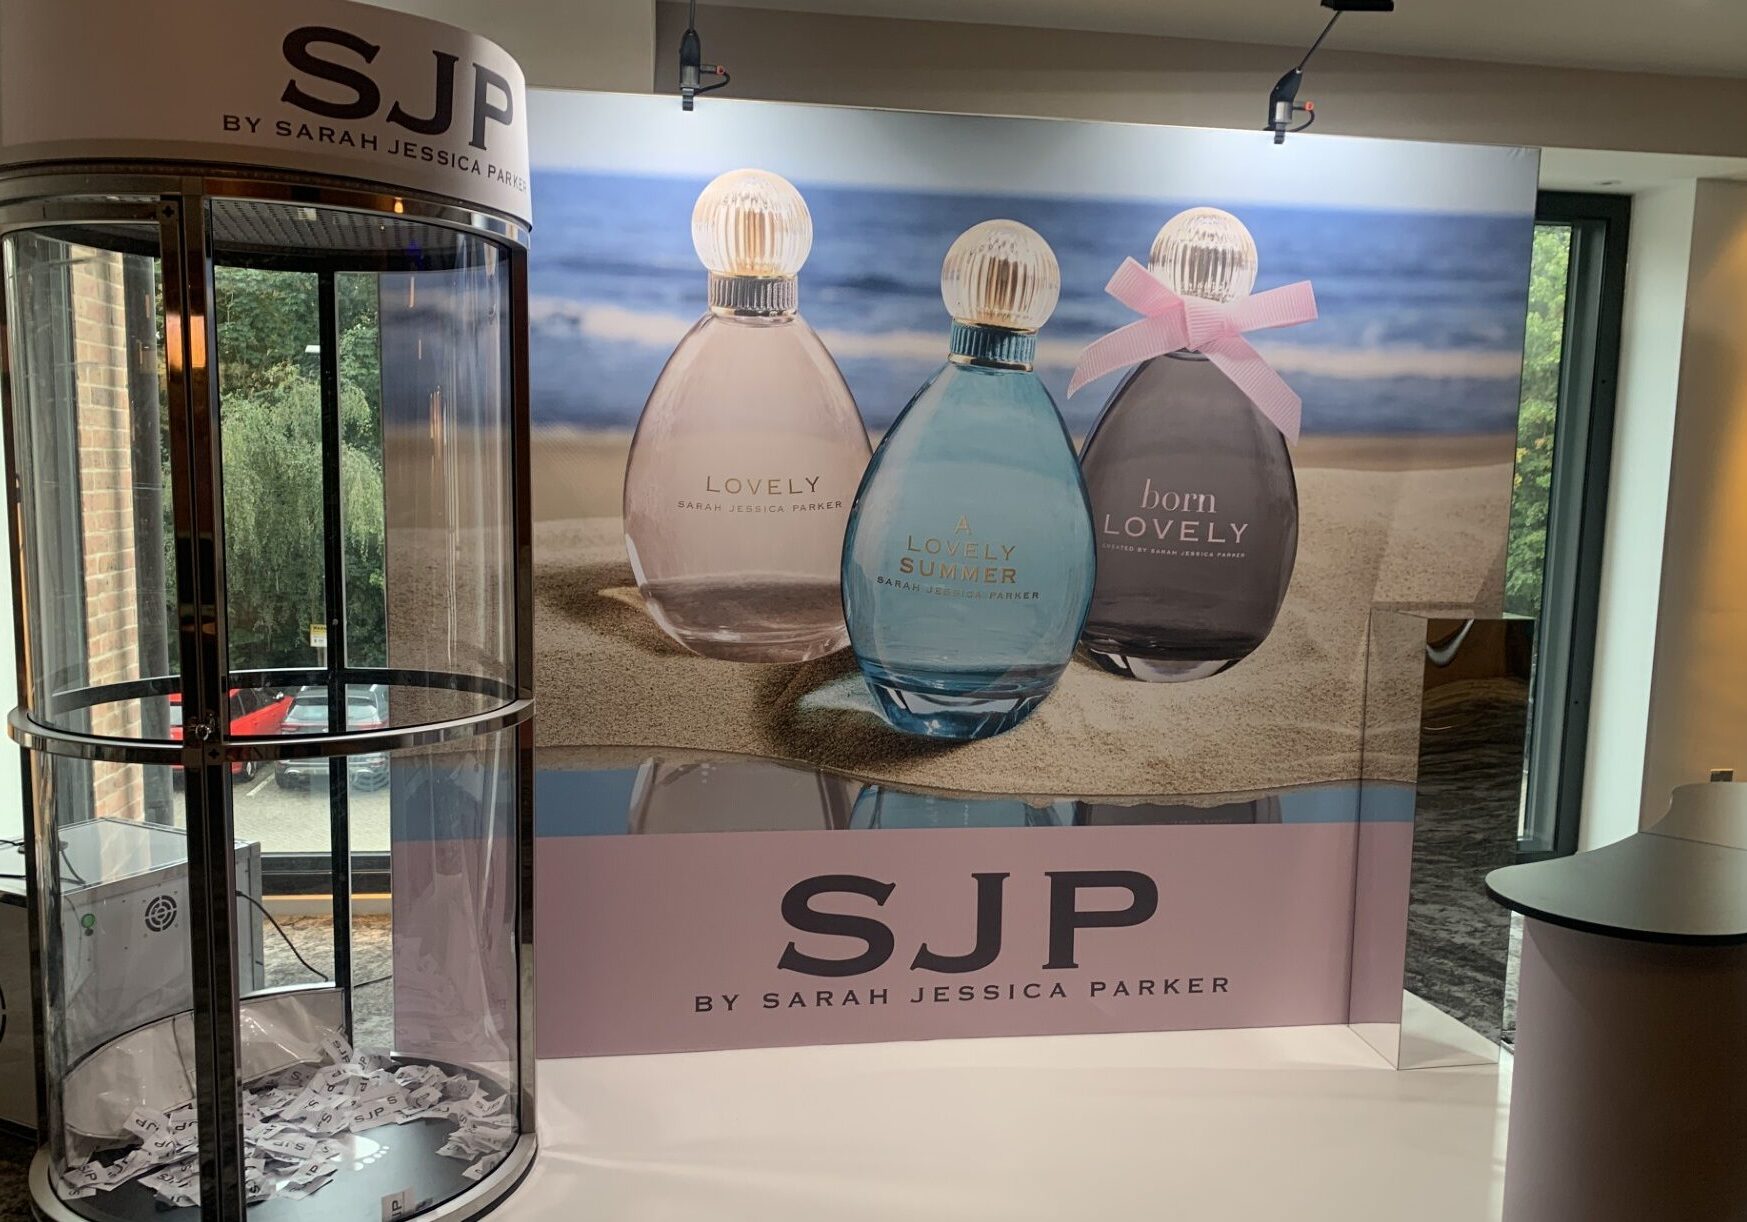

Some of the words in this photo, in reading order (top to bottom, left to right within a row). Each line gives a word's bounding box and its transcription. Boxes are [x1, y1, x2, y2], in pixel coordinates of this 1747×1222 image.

[281, 25, 514, 151] SJP
[222, 115, 261, 133] BY
[275, 120, 378, 151] SARAH
[387, 139, 482, 176] JESSICA
[487, 163, 528, 193] PARKER
[706, 475, 820, 496] LOVELY
[1140, 477, 1218, 514] born
[677, 500, 722, 512] SARAH
[728, 504, 785, 513] JESSICA
[792, 500, 843, 513] PARKER
[954, 513, 972, 535] A
[1103, 513, 1249, 544] LOVELY
[907, 534, 1017, 561] LOVELY
[899, 556, 1017, 585] SUMMER
[876, 575, 921, 592] SARAH
[988, 590, 1040, 600] PARKER
[776, 869, 1160, 978] SJP
[694, 994, 741, 1013] BY
[762, 987, 890, 1010] SARAH
[909, 981, 1069, 1004] JESSICA
[1089, 975, 1231, 999] PARKER
[354, 1106, 385, 1123] SJP
